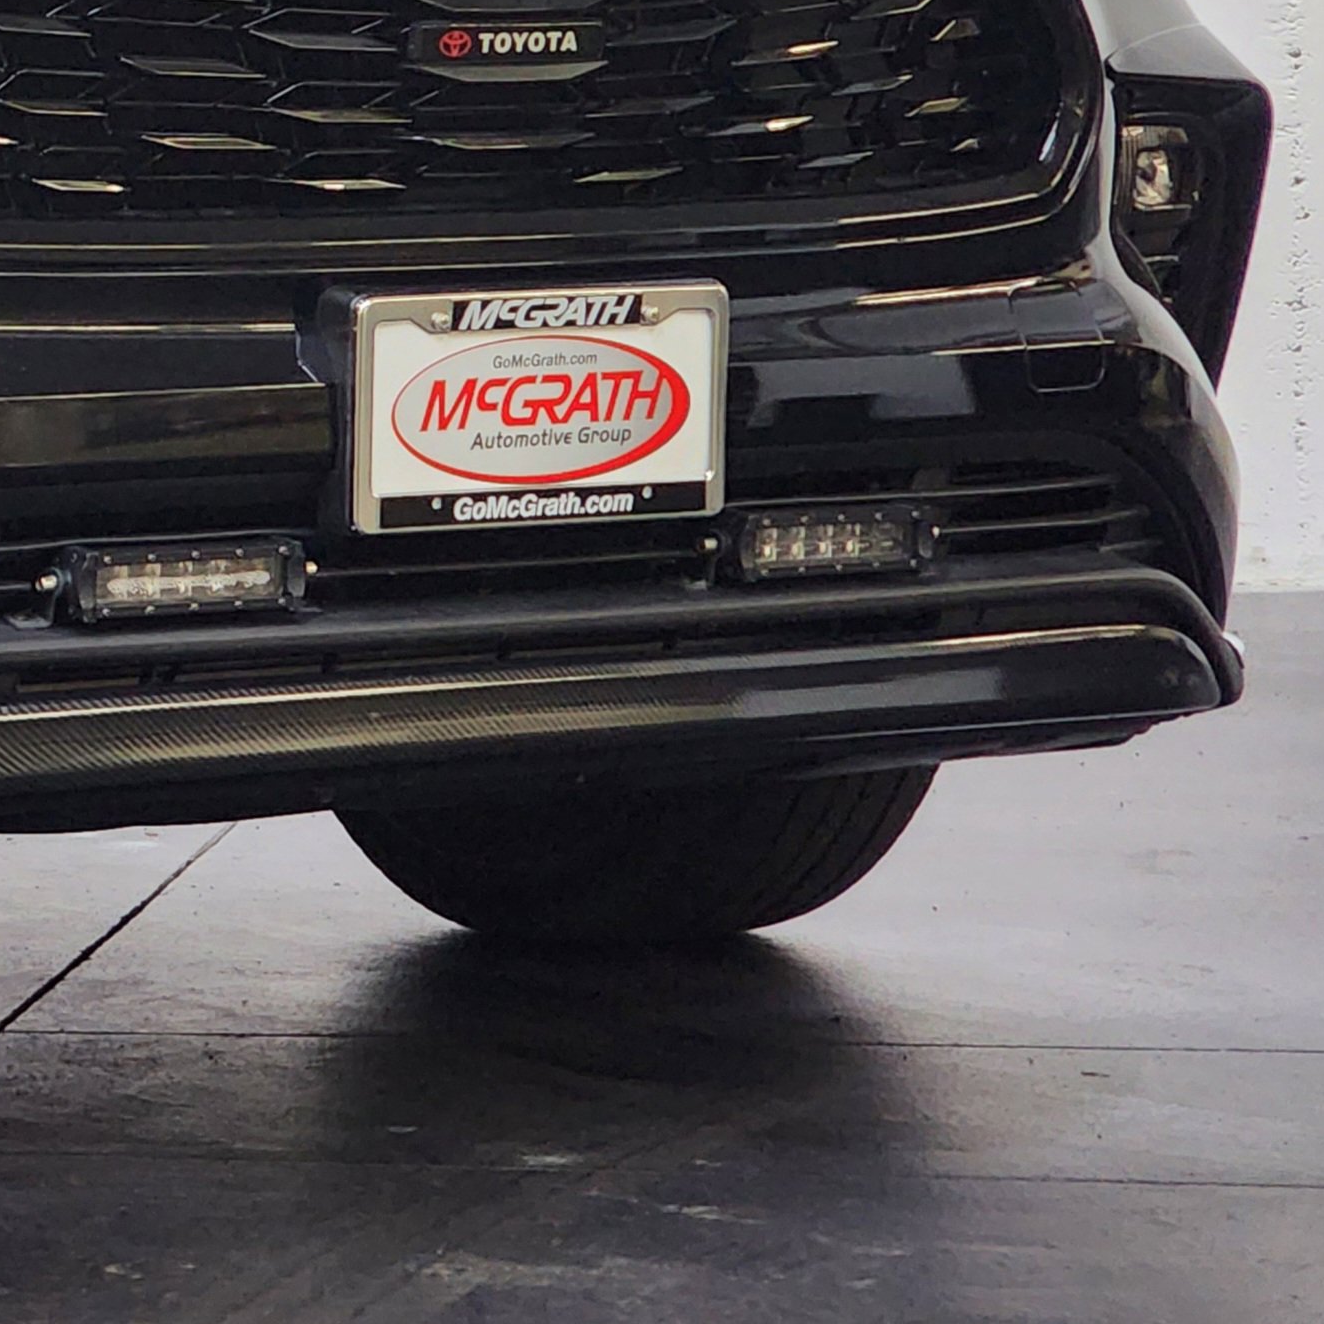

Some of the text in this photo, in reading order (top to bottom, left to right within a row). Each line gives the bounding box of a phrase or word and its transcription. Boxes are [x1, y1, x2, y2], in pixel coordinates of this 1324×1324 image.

[477, 30, 579, 55] TOYOTA
[492, 351, 599, 370] GoMcGrath.com
[470, 426, 633, 451] Automotive Group
[453, 490, 635, 522] GoMcGrath.com
